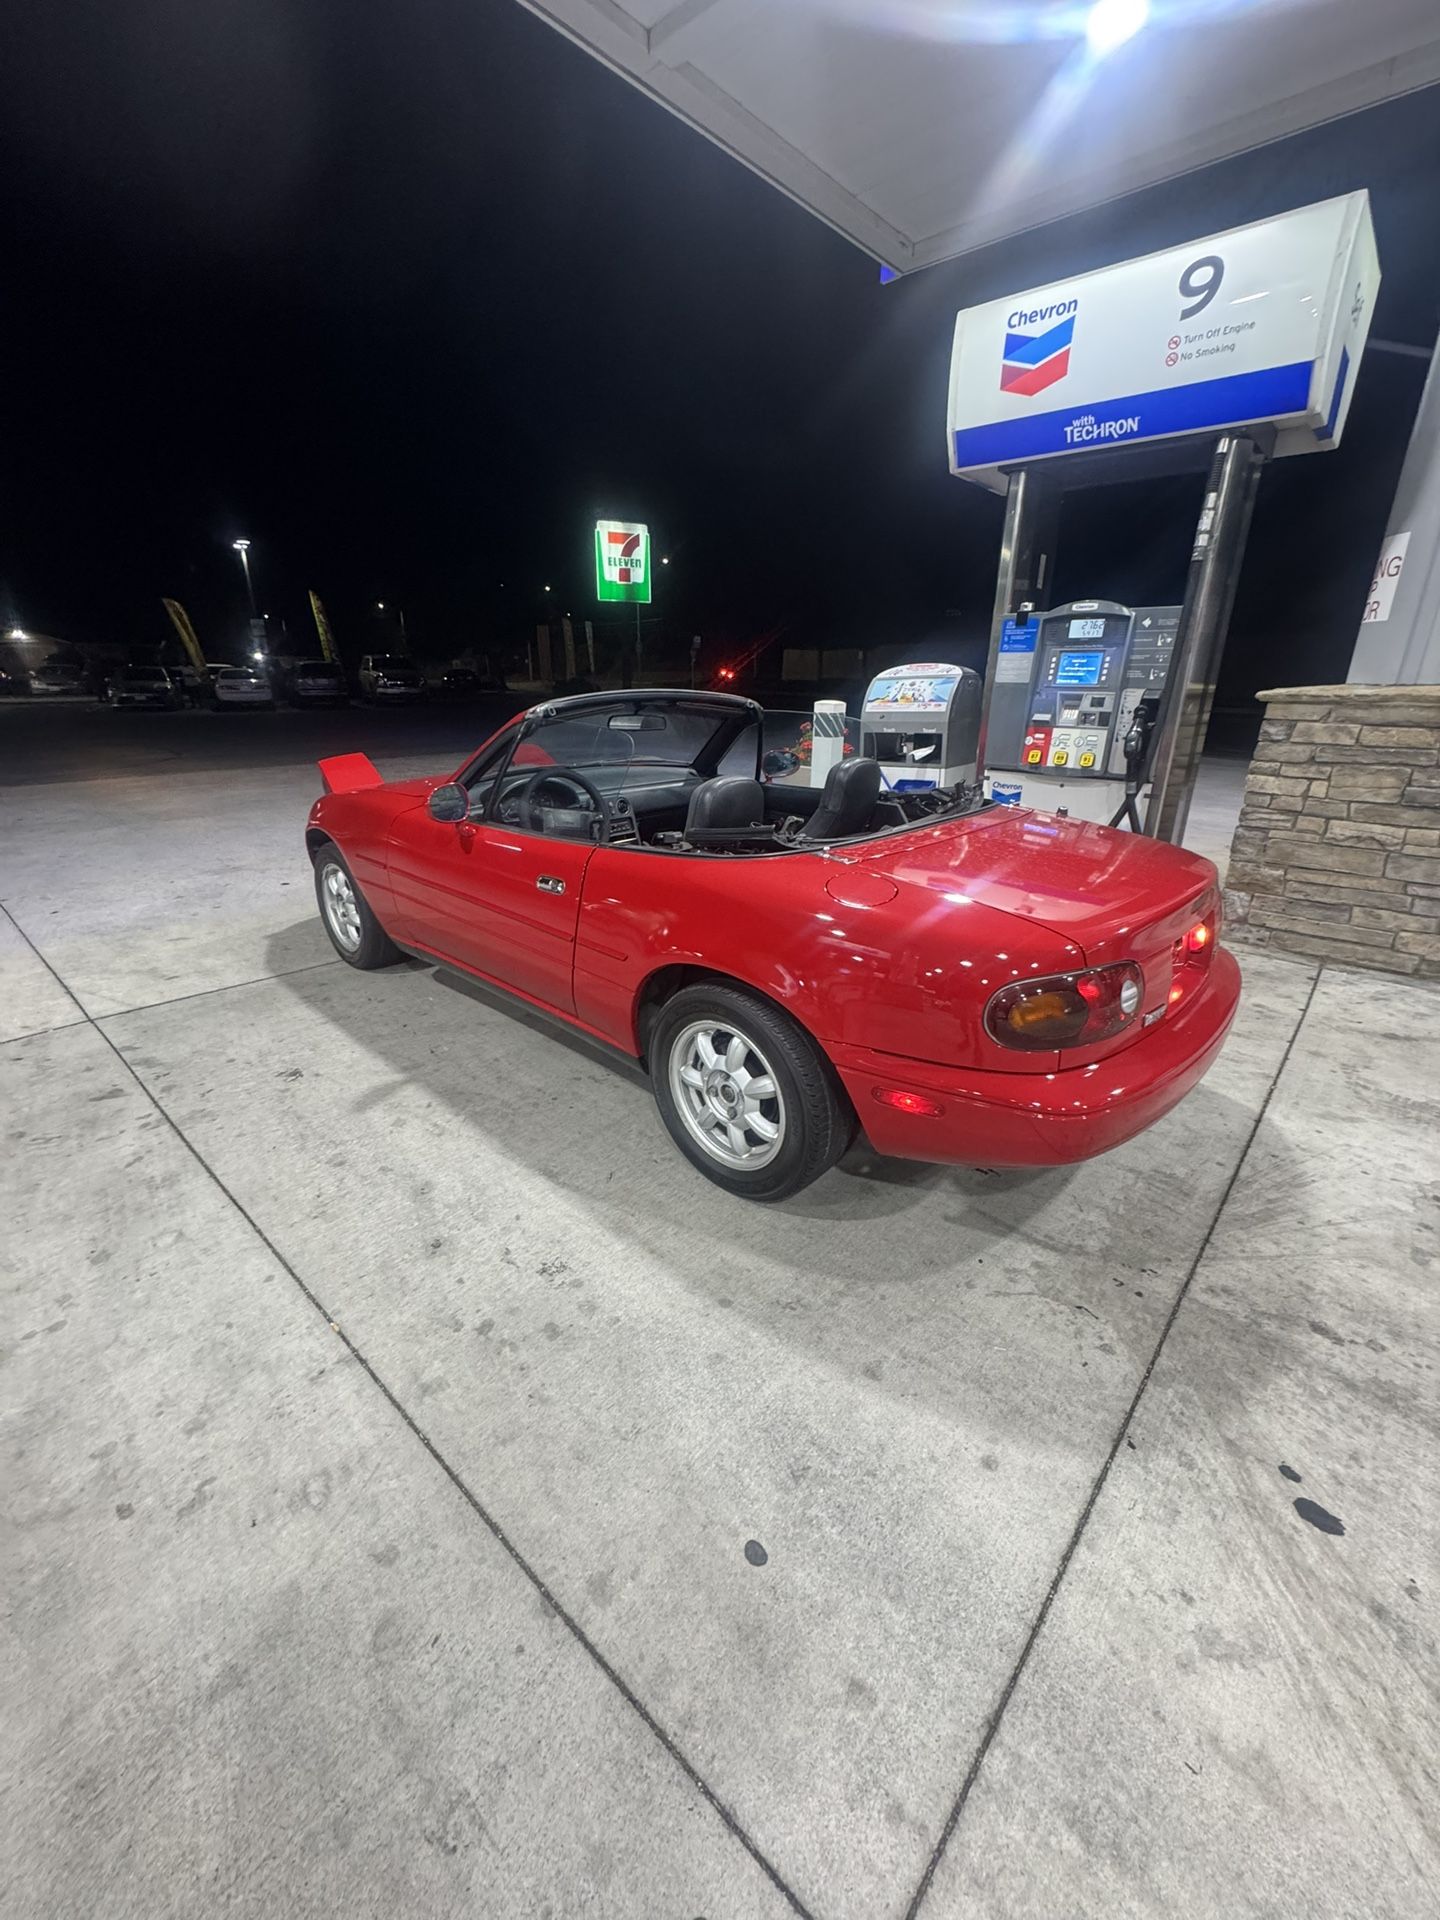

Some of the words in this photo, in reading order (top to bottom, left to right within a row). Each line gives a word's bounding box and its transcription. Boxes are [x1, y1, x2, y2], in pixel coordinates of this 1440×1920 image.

[1179, 255, 1225, 321] 9
[1007, 299, 1078, 329] Chevron
[1183, 335, 1204, 344] Turn
[1206, 327, 1221, 339] Off
[1223, 321, 1256, 336] Engine
[1180, 352, 1193, 361] No
[1195, 343, 1236, 358] Smoking
[1064, 416, 1141, 443] TECHRON
[1072, 414, 1095, 427] with
[992, 781, 1023, 790] Chevron
